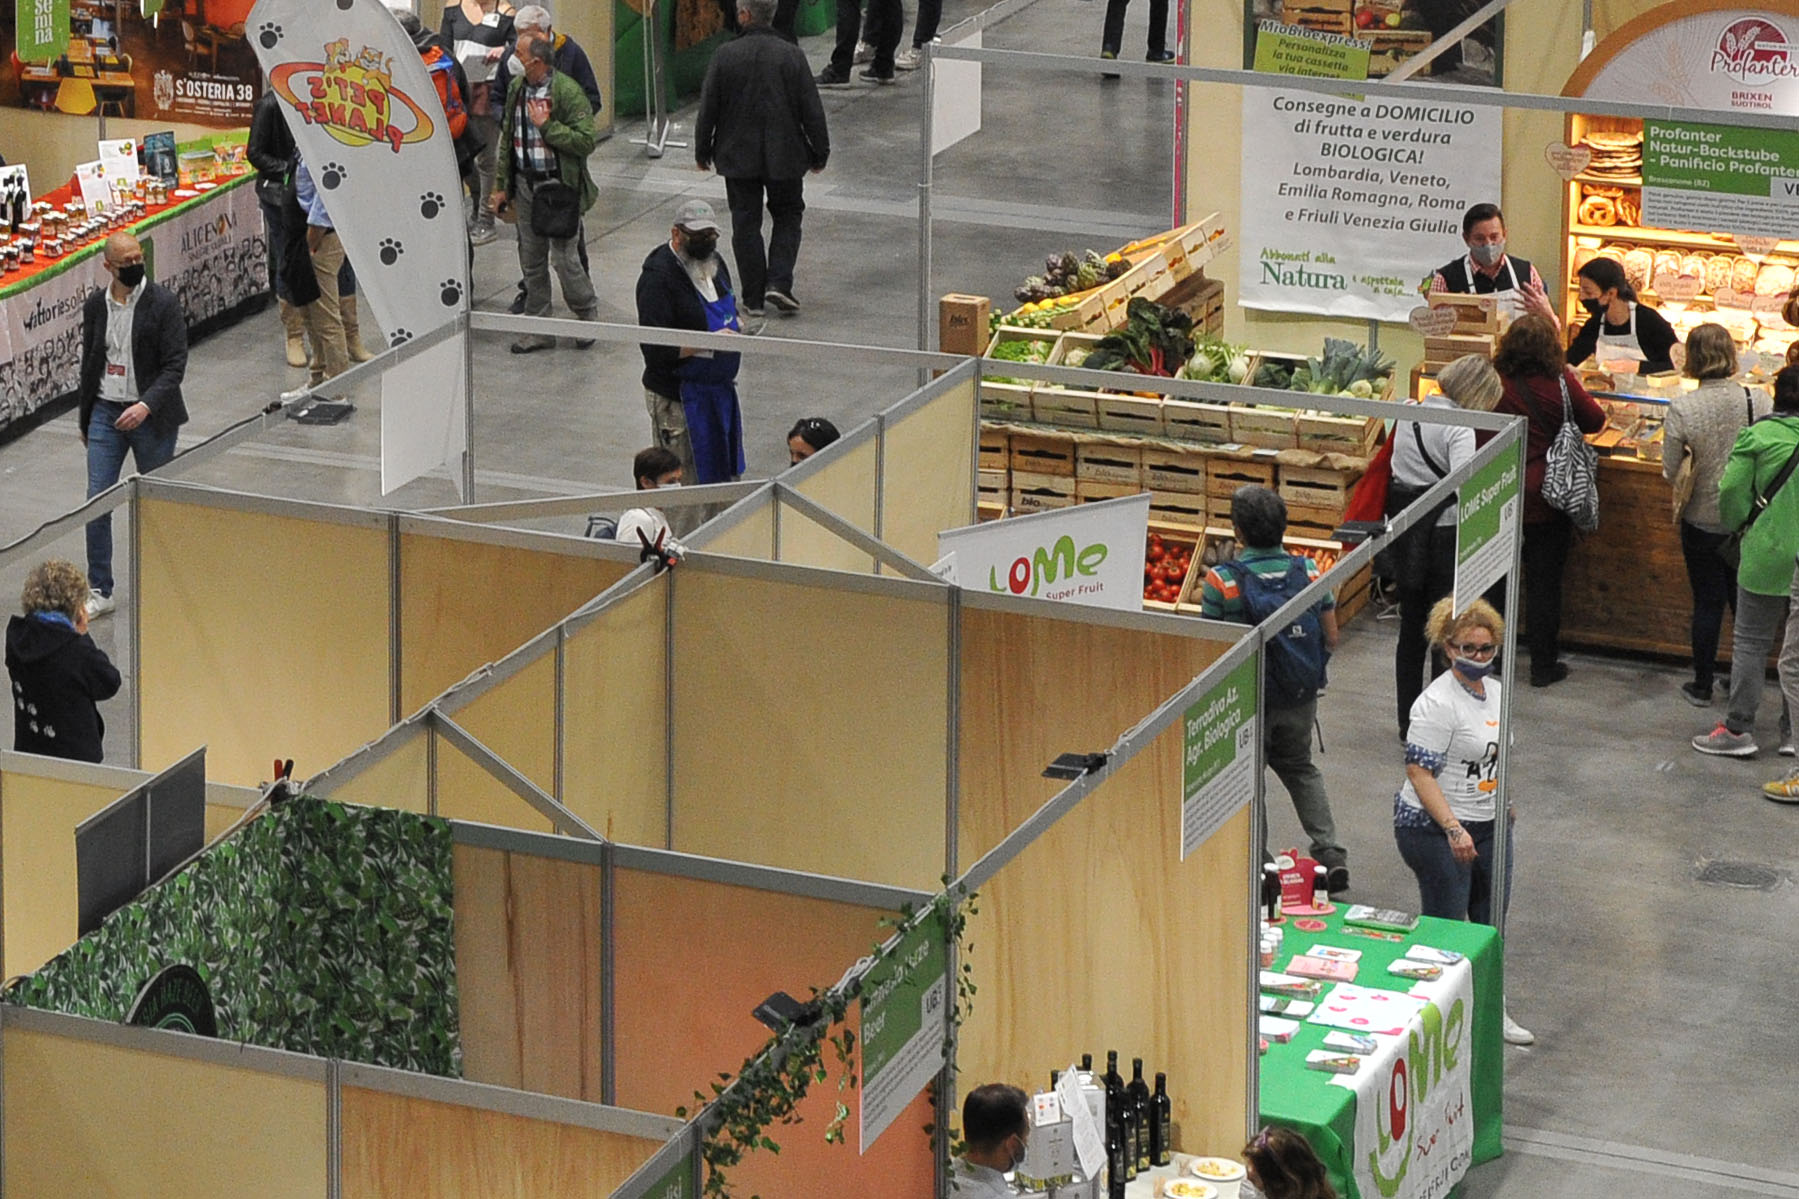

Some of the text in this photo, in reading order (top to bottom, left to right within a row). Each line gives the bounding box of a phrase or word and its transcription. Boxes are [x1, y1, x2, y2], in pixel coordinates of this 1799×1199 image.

[35, 12, 53, 29] mi
[35, 26, 54, 45] na
[1259, 18, 1373, 51] MioBioexpress!
[1272, 50, 1349, 73] la tua cassetta
[1278, 38, 1347, 60] Personalizza
[1278, 63, 1295, 75] via
[1710, 50, 1799, 82] Profanter
[175, 77, 253, 101] S'OSTERIA 38
[1731, 91, 1774, 102] BRIXEN
[1272, 96, 1475, 126] Consegne a DOMICILIO
[1294, 118, 1452, 145] di frutta e verdura
[1649, 125, 1723, 143] Profanter
[1320, 141, 1425, 166] BIOLOGICA!
[1649, 140, 1781, 163] Natur-Backstube
[1292, 161, 1452, 191] Lombardia, Veneto,
[1660, 155, 1726, 174] Panificio
[1277, 182, 1466, 211] Emilia Romagna, Roma
[1284, 207, 1459, 235] e Friuli Venezia Giulia
[1259, 246, 1337, 264] Abbonati alla
[1259, 260, 1349, 291] Natura
[1460, 463, 1518, 524] LOME Super Fruit
[1045, 582, 1104, 601] Super Fruit
[1186, 685, 1240, 740] Terradiva Az.
[1186, 708, 1241, 767] Agr. Biologica
[863, 1010, 887, 1046] Beer
